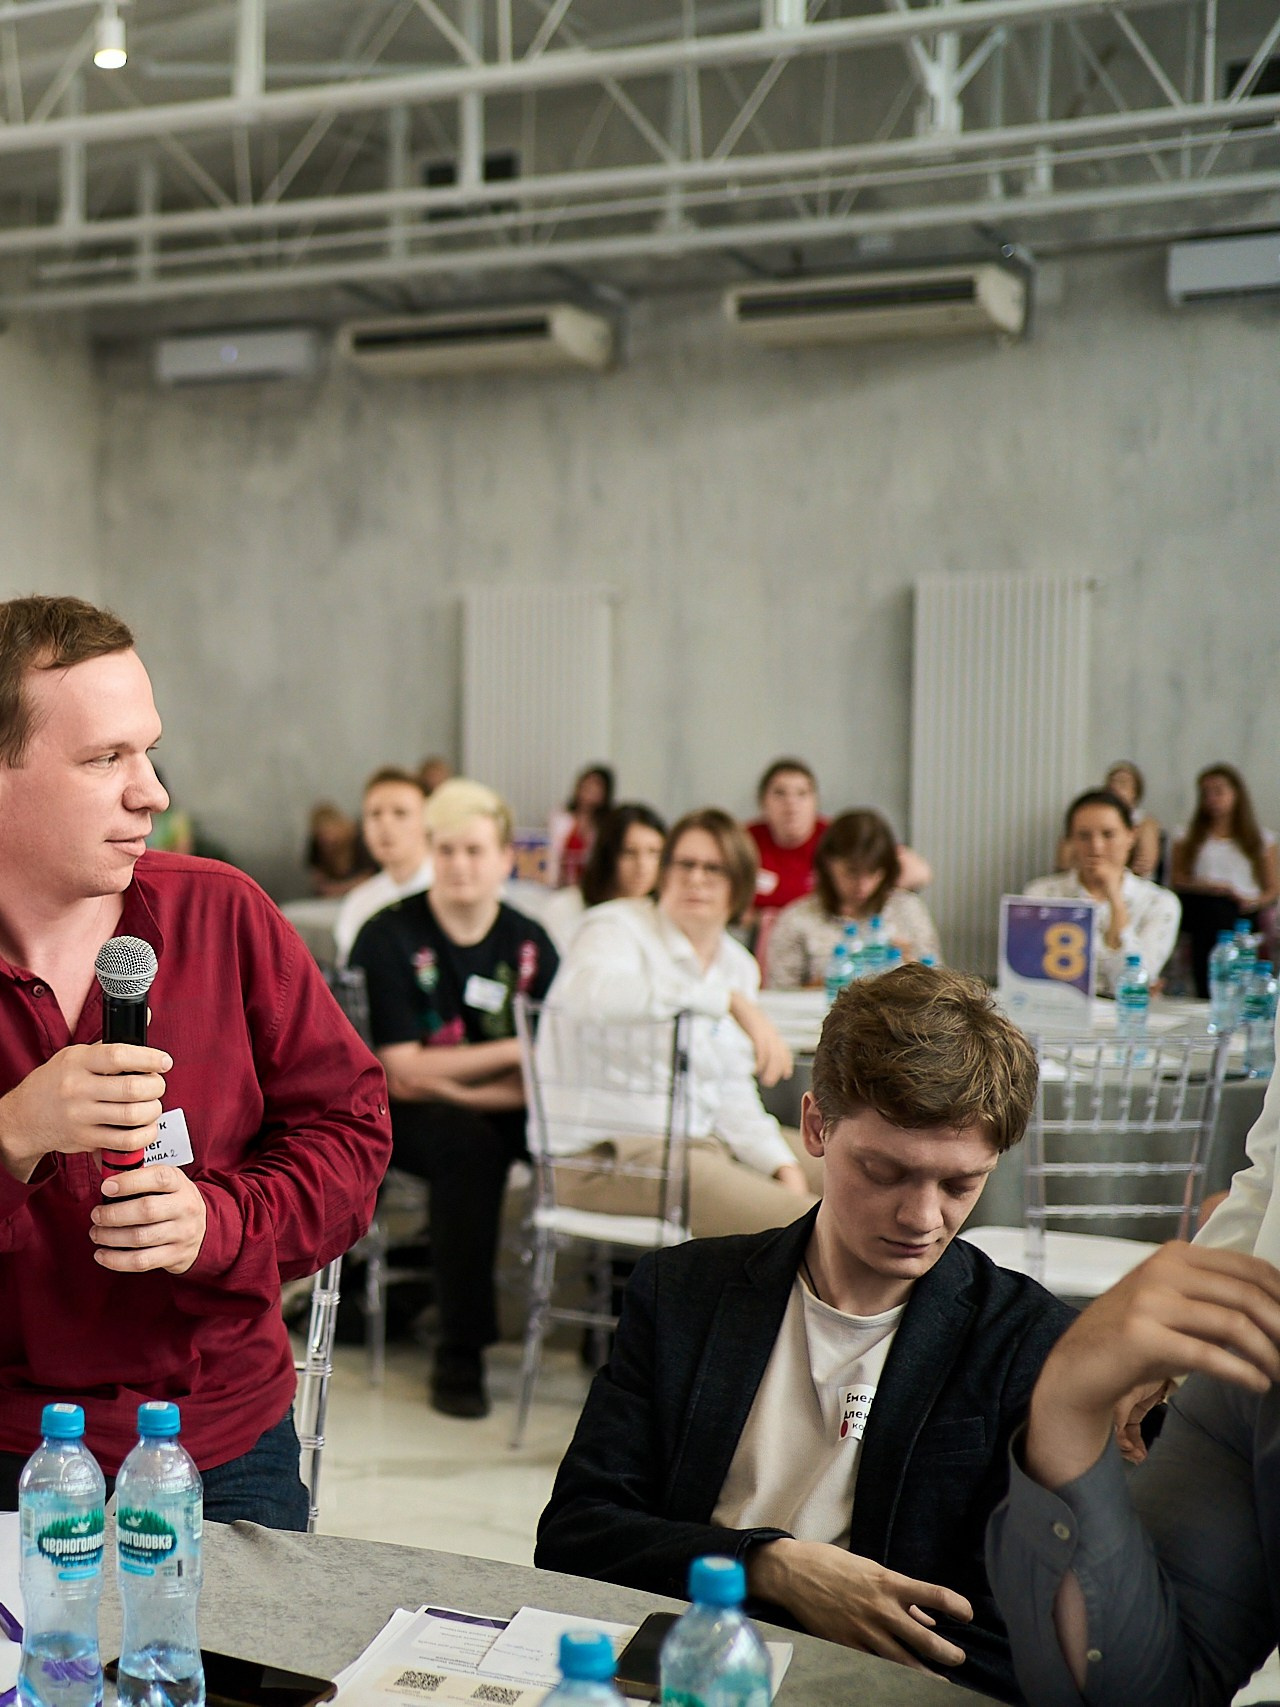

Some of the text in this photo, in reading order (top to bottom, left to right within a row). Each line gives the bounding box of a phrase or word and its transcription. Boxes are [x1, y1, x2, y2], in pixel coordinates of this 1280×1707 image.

[1042, 922, 1086, 981] 8
[144, 1149, 178, 1164] АНДА 2
[846, 1392, 874, 1404] Емел
[844, 1410, 869, 1420] Алек
